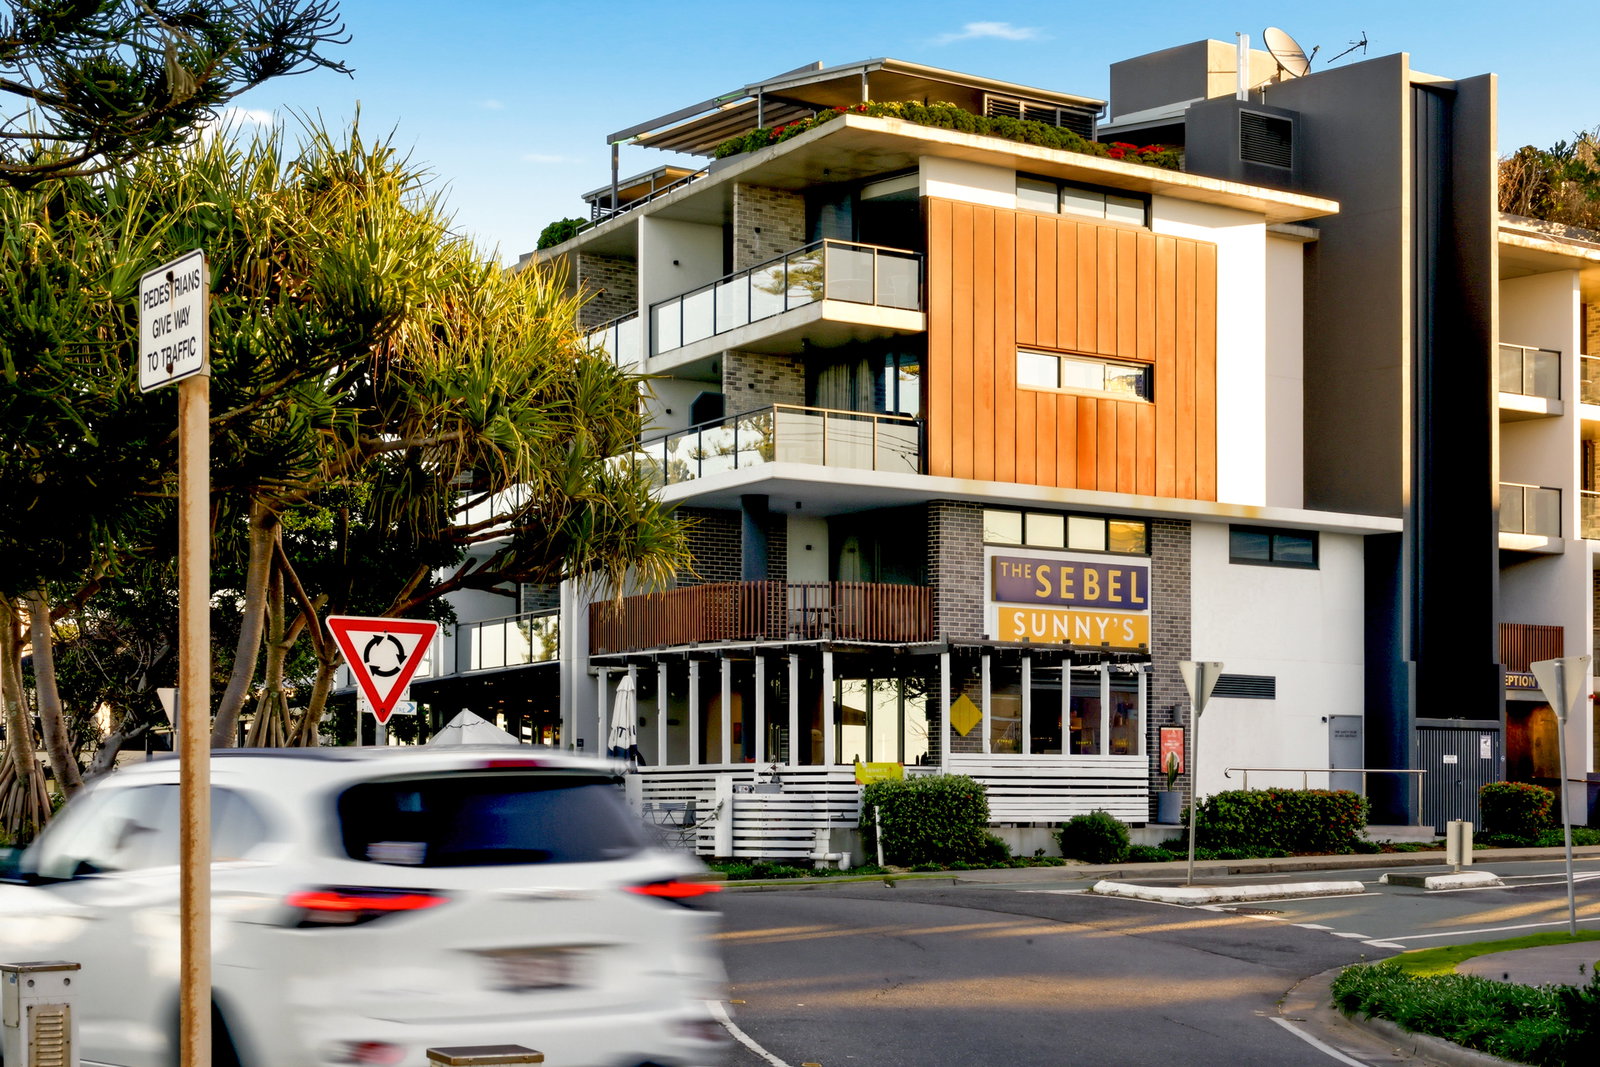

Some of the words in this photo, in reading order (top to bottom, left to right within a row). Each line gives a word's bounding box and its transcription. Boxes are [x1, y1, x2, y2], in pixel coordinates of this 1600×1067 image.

[143, 269, 200, 311] PEDESTRIANS
[152, 314, 172, 339] GIVE
[174, 305, 191, 330] WAY
[147, 351, 159, 372] TO
[160, 336, 196, 368] TRAFFIC
[1000, 562, 1032, 579] THE
[1035, 564, 1144, 604] SEBEL
[1013, 611, 1135, 642] SUNNY'S
